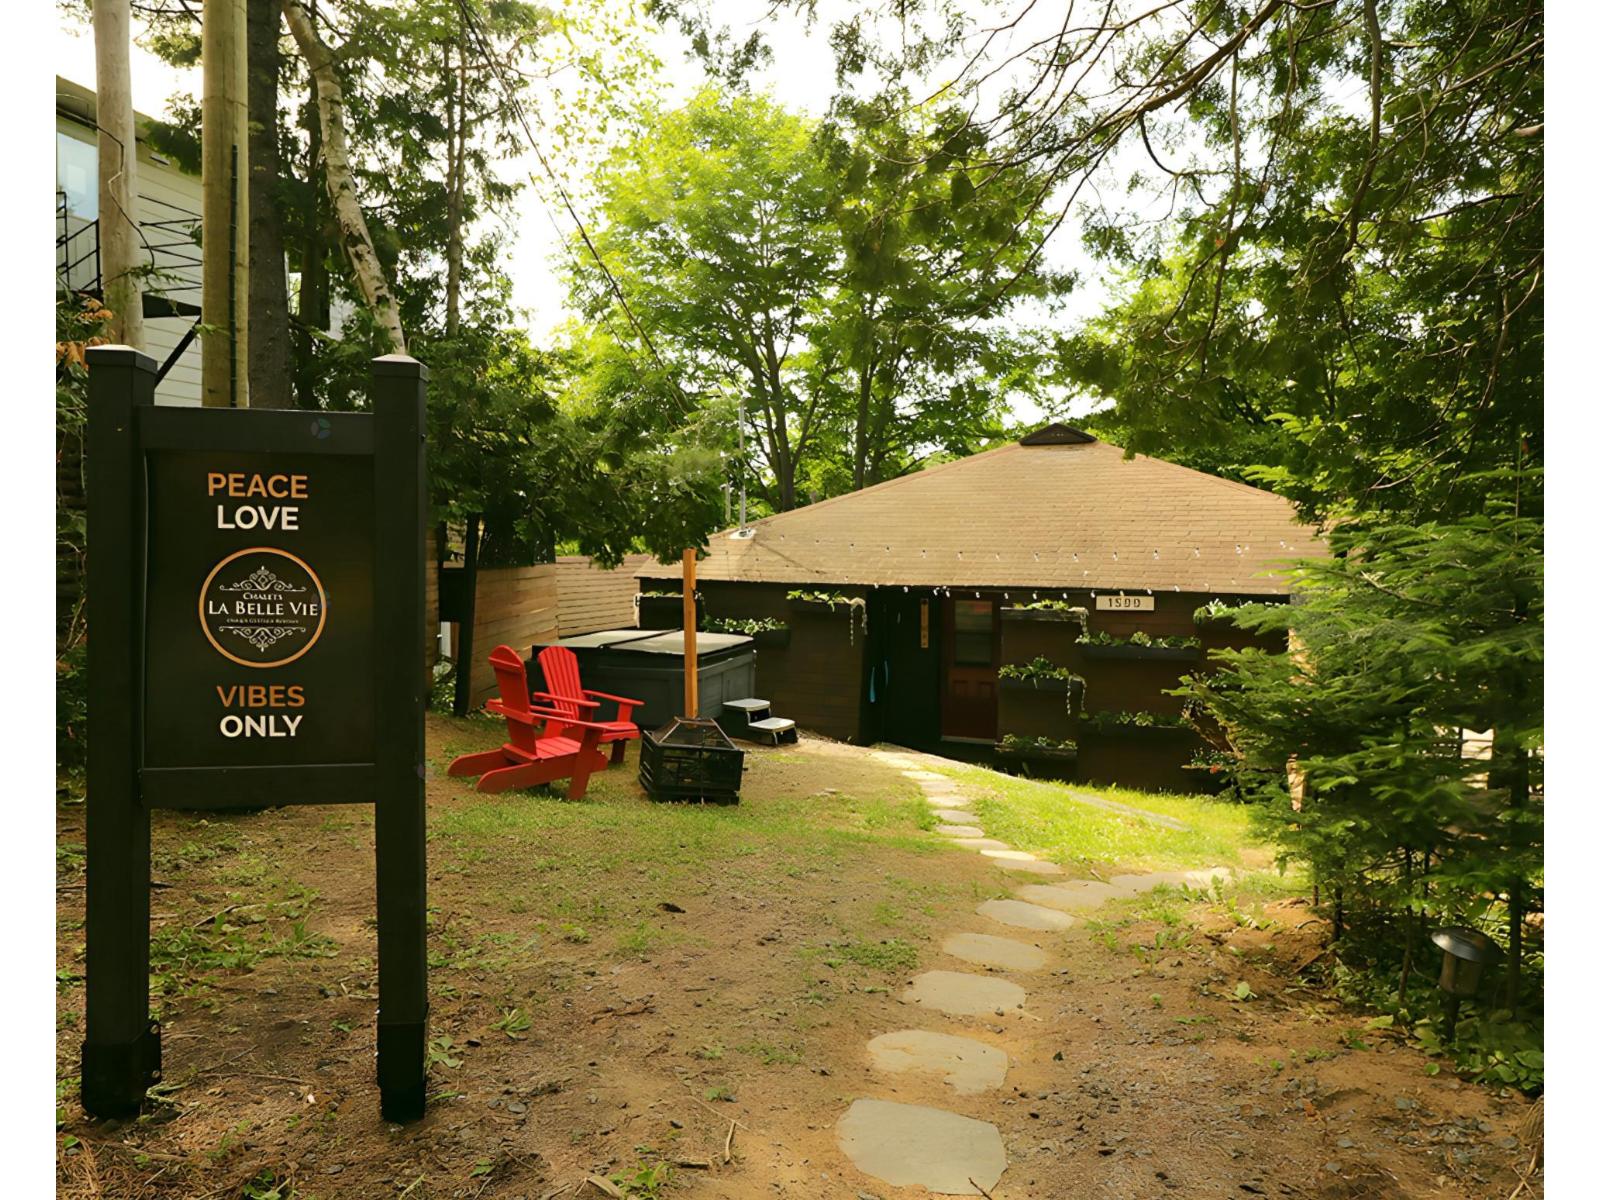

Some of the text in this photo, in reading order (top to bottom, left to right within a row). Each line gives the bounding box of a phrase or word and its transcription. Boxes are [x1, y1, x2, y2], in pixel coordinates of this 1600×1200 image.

[208, 473, 308, 498] PEACE
[217, 505, 299, 530] LOVE
[208, 600, 319, 616] LA BELLE VIE
[216, 685, 306, 708] VIBES
[220, 715, 303, 738] ONLY
